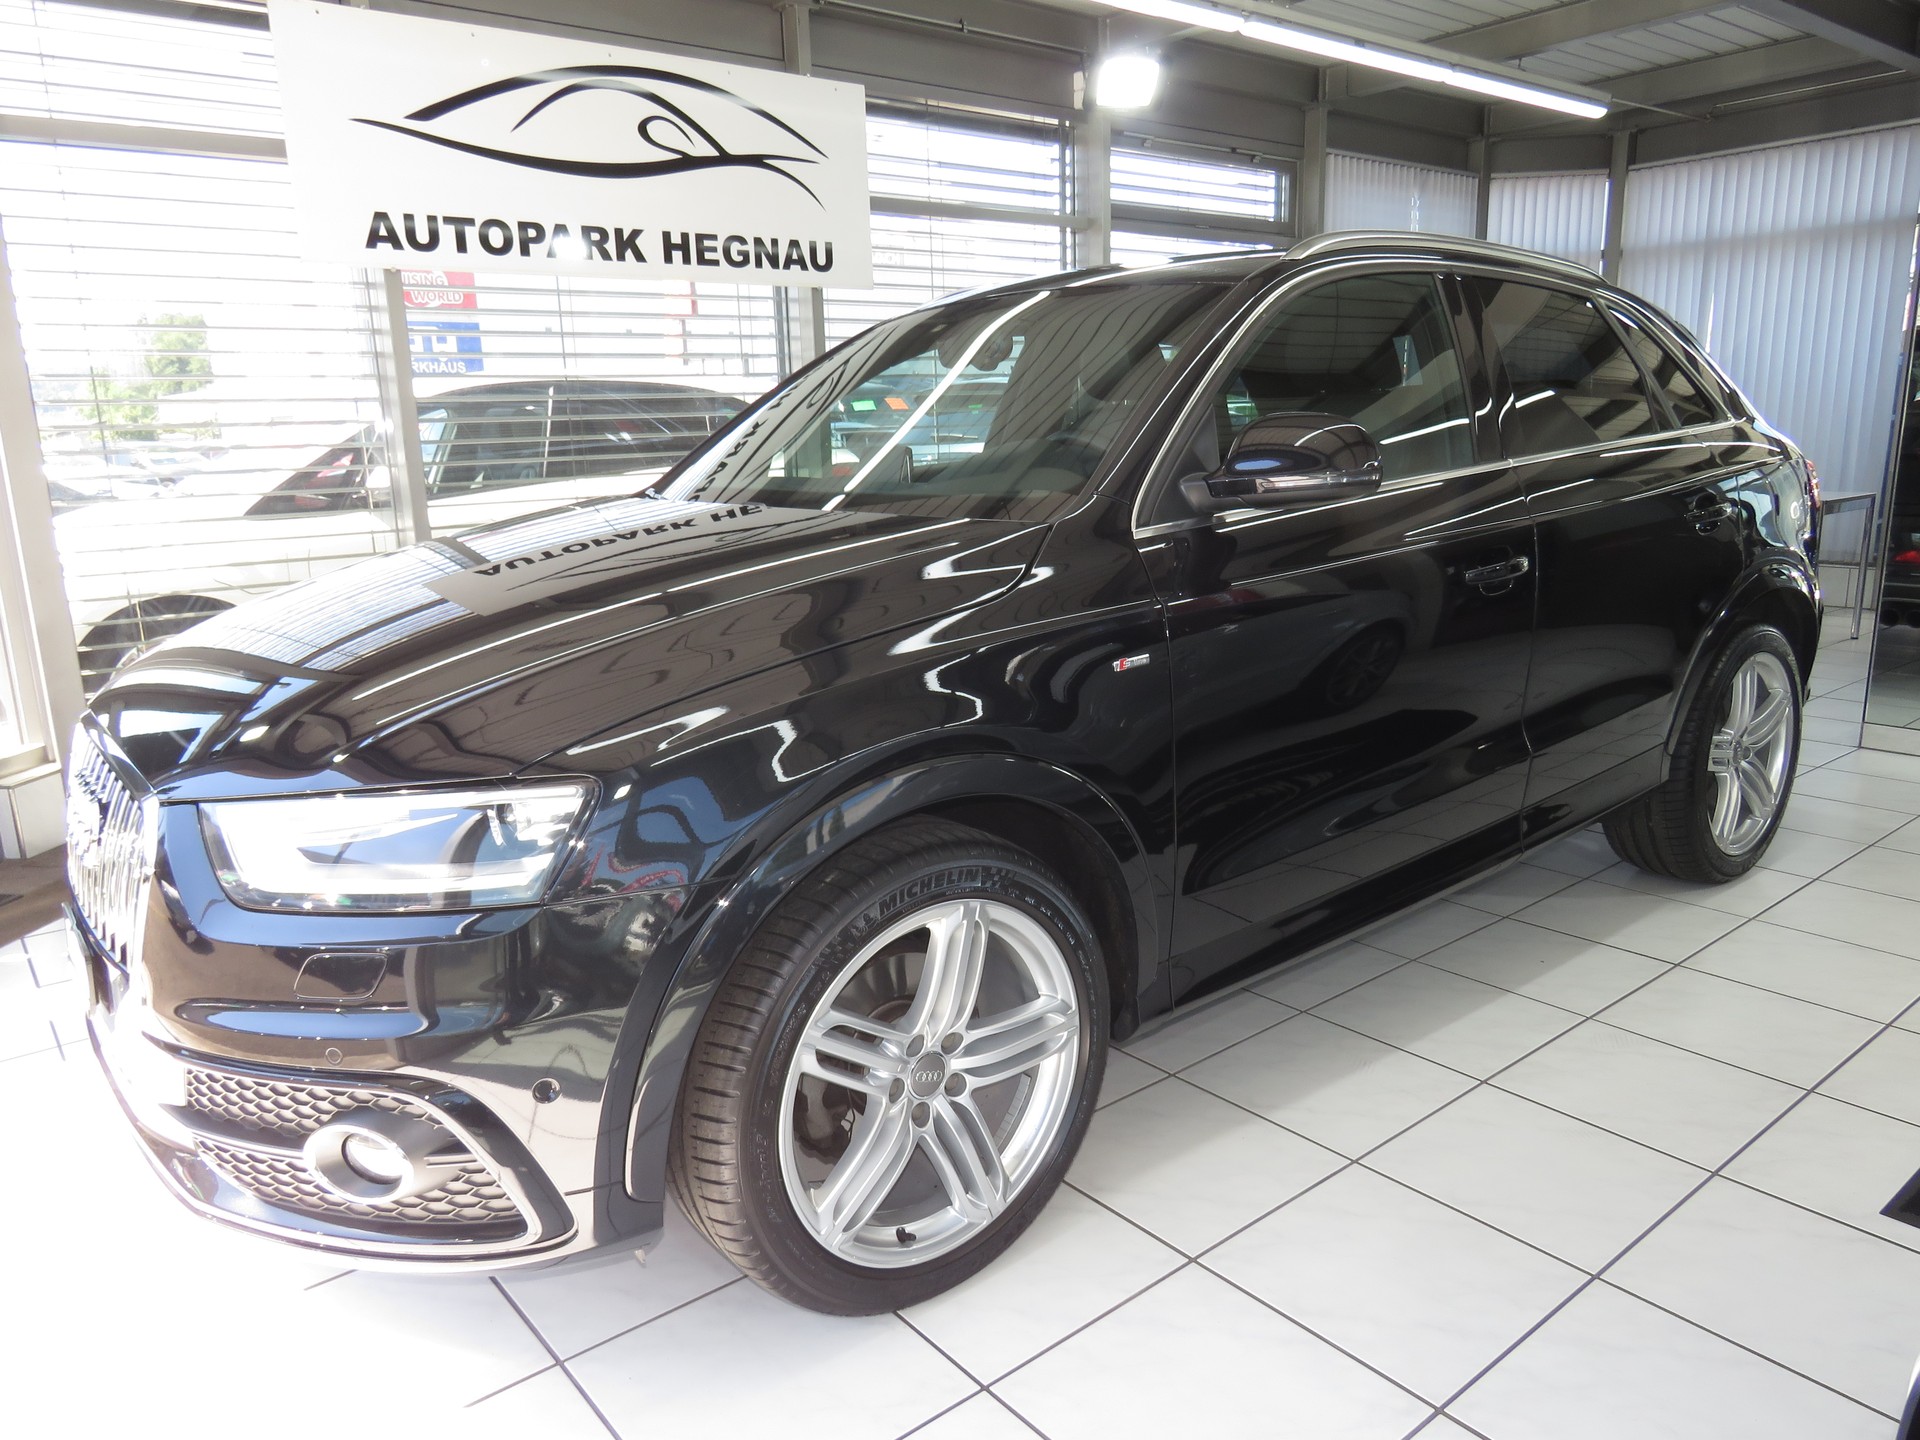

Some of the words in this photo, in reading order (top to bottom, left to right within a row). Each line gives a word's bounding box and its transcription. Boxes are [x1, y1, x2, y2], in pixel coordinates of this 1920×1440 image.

[365, 211, 646, 263] AUTOPARK
[661, 231, 834, 273] HEGNAU
[412, 290, 462, 303] WORLD
[878, 867, 981, 918] MICHELIN
